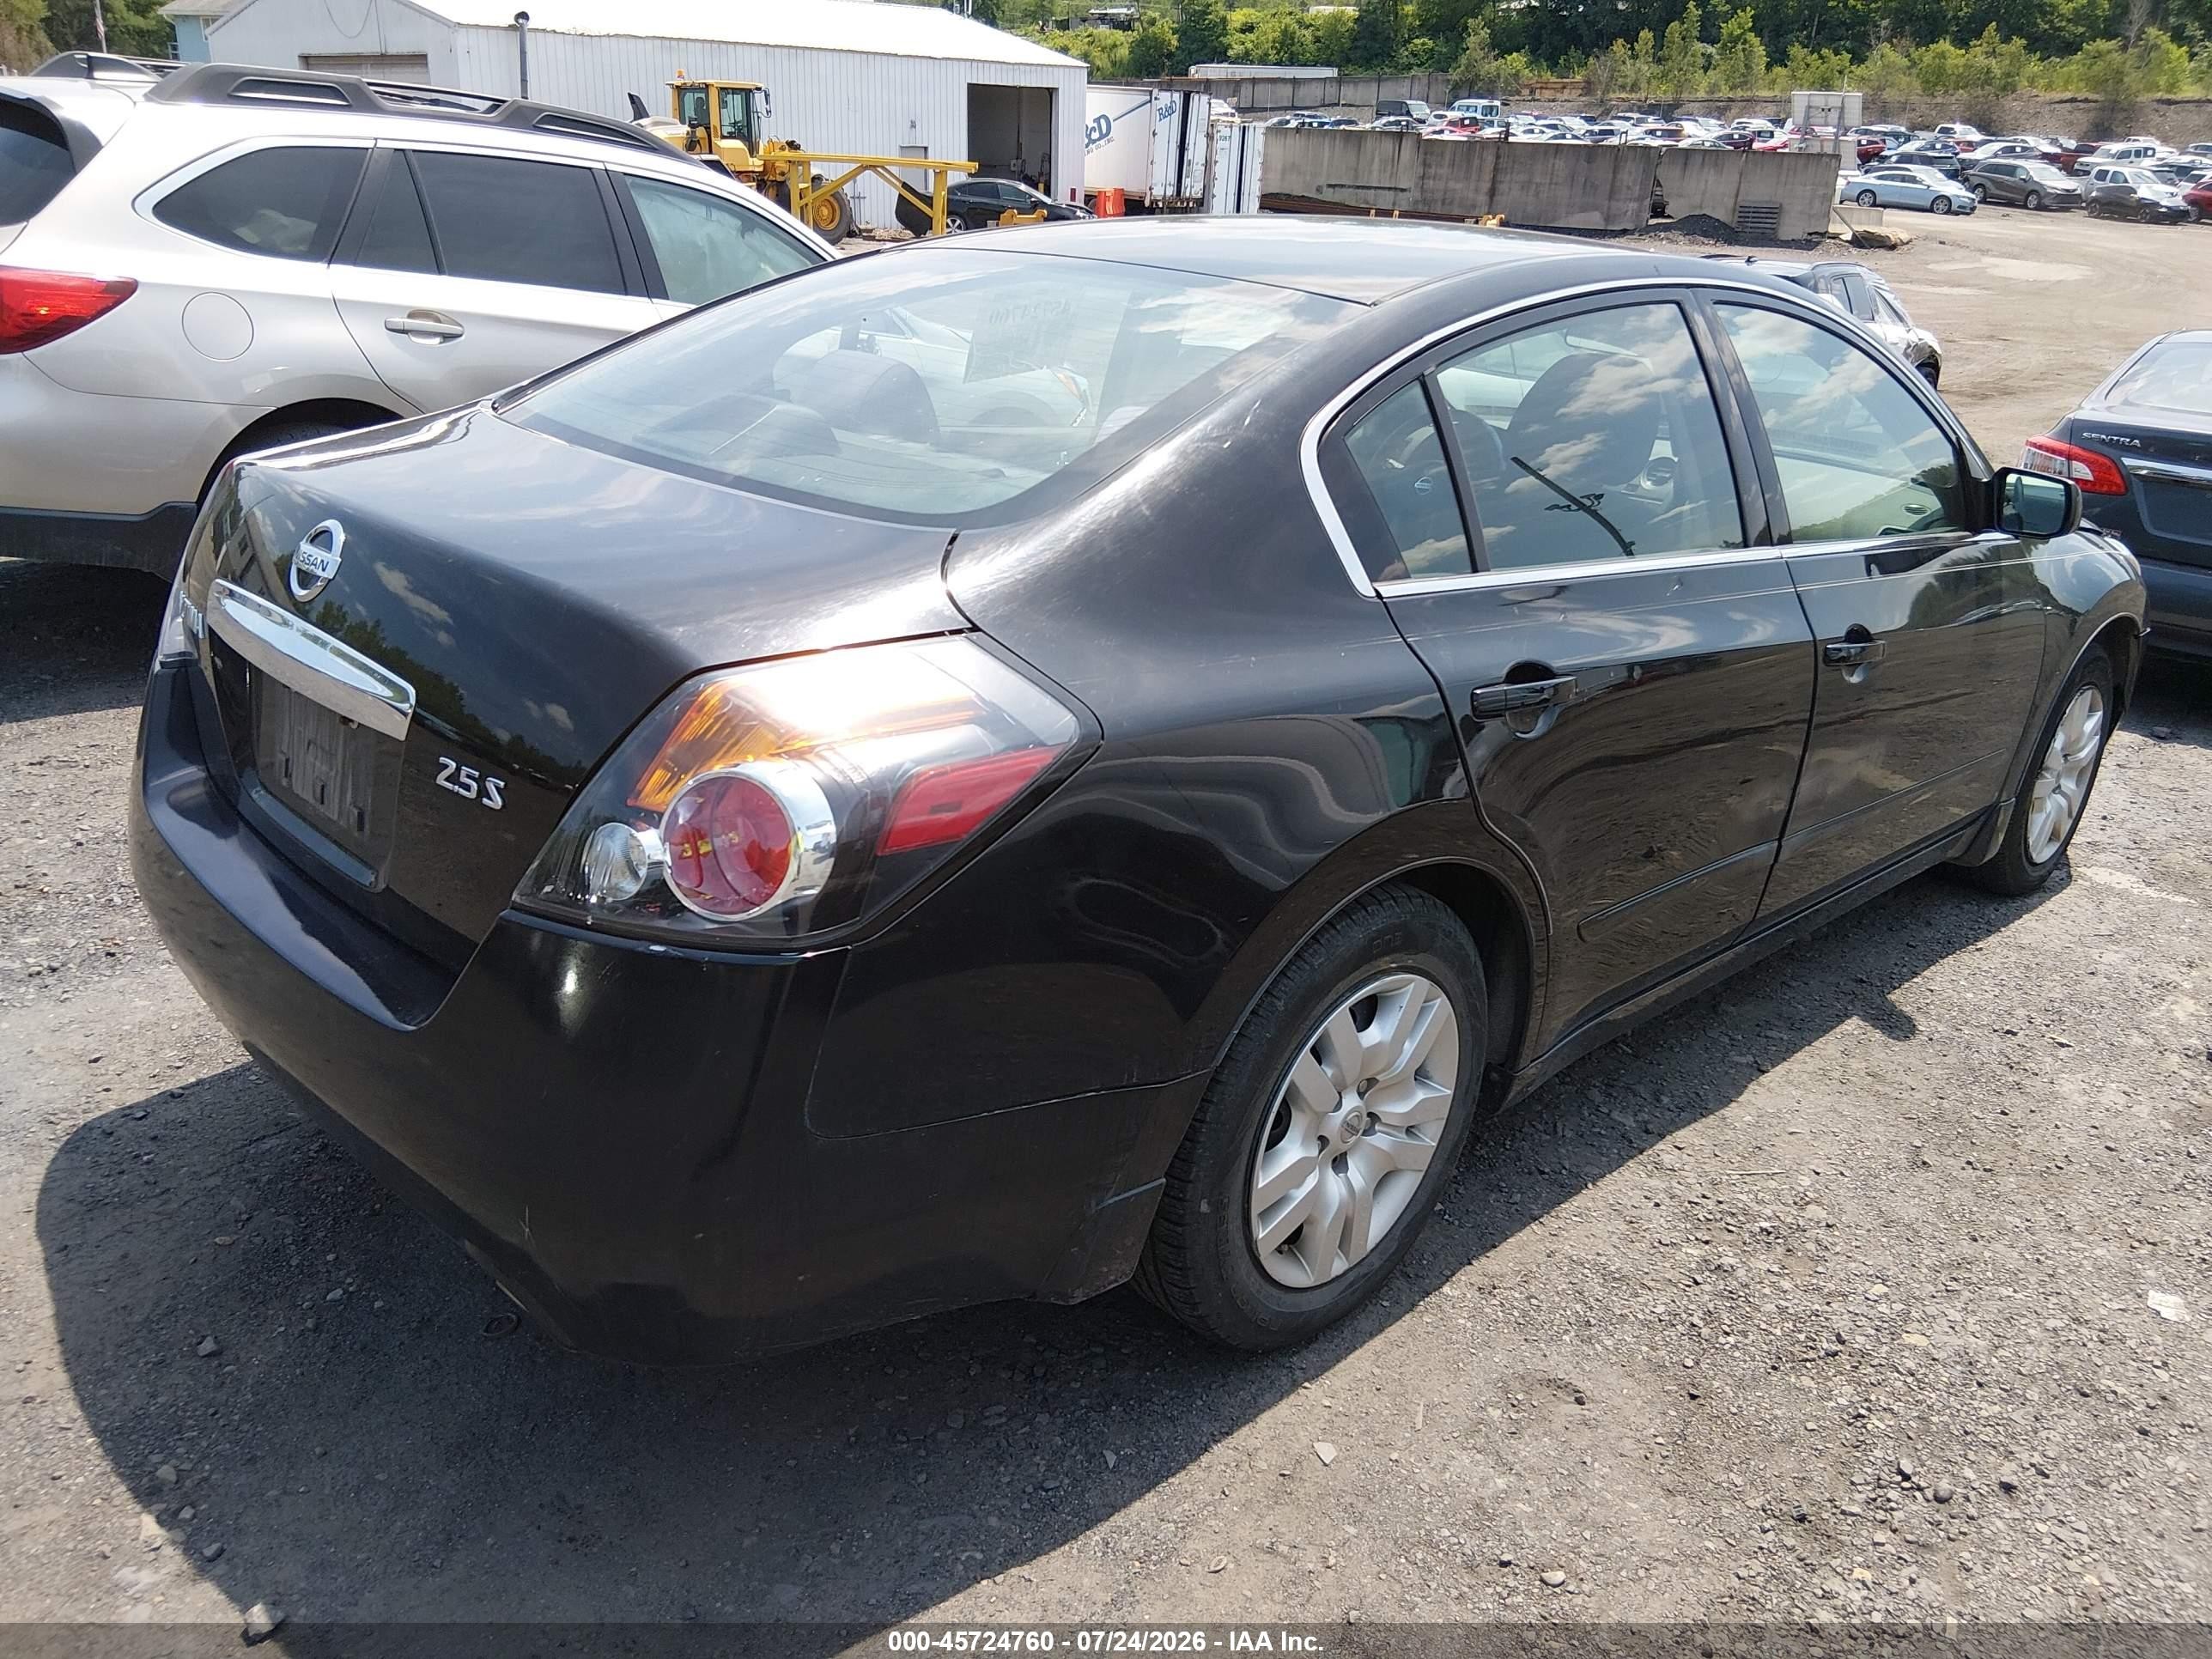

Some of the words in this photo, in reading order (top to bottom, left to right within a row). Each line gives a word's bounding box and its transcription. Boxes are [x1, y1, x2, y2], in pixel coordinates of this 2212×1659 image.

[1158, 100, 1176, 122] R&D
[2081, 432, 2142, 447] SENTRA
[482, 777, 506, 810] S
